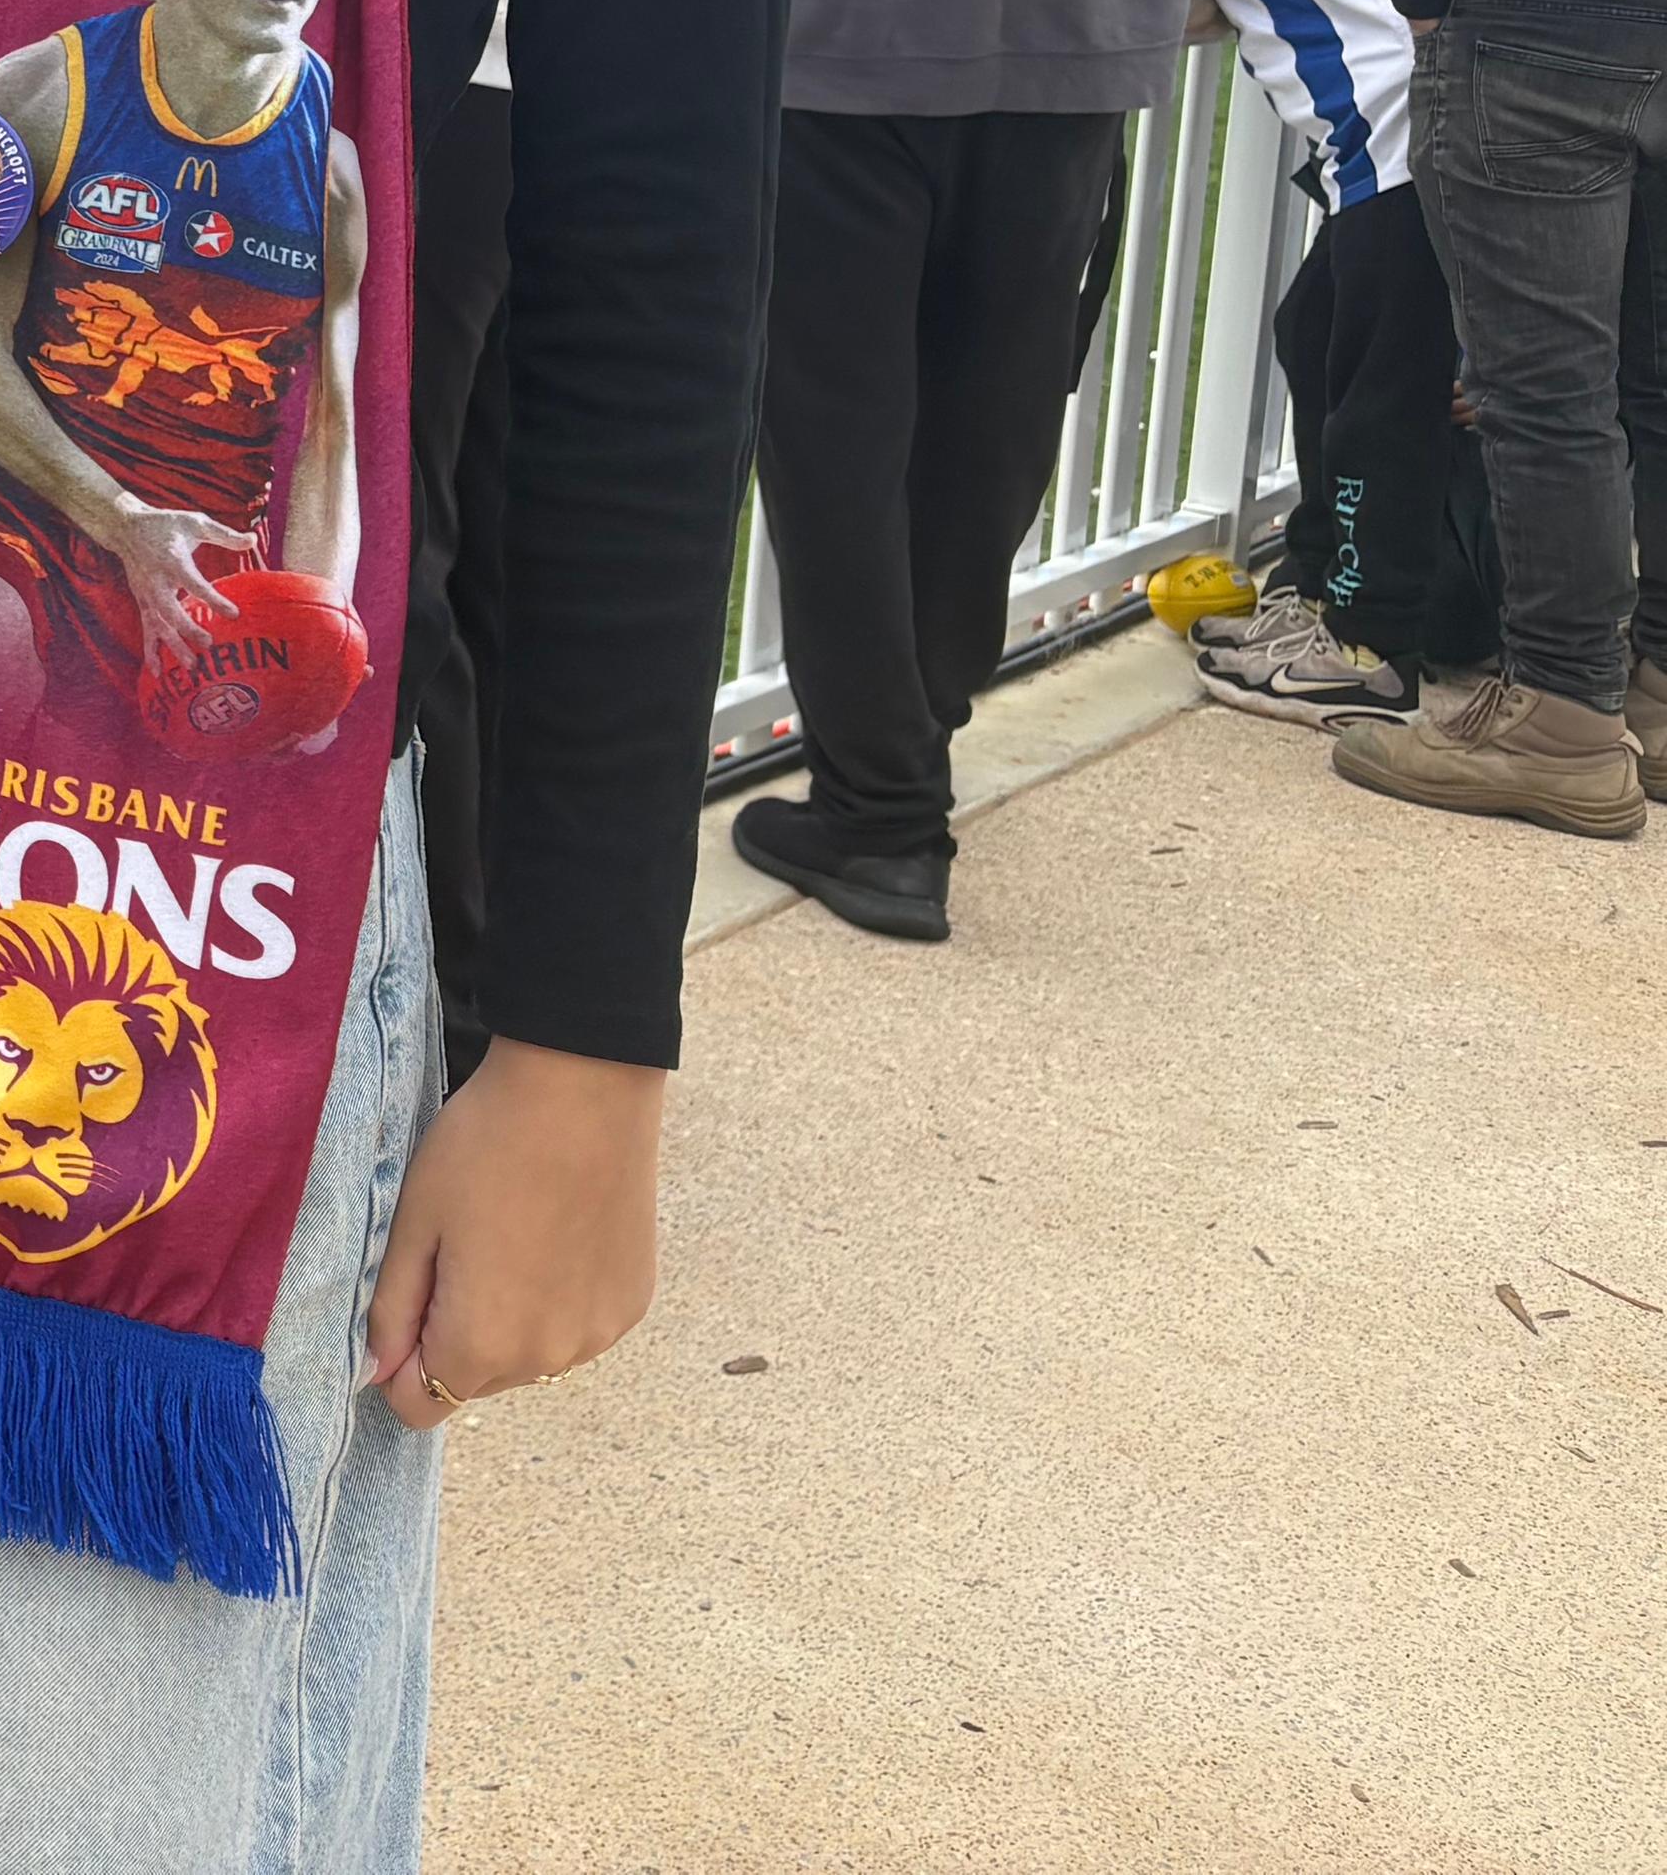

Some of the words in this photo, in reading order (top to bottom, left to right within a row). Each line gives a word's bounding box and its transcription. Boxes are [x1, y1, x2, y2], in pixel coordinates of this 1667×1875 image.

[77, 183, 159, 221] AFL
[61, 227, 111, 248] GRAND
[242, 237, 317, 271] CALTEX
[93, 252, 120, 267] 2024
[194, 689, 257, 732] AFL
